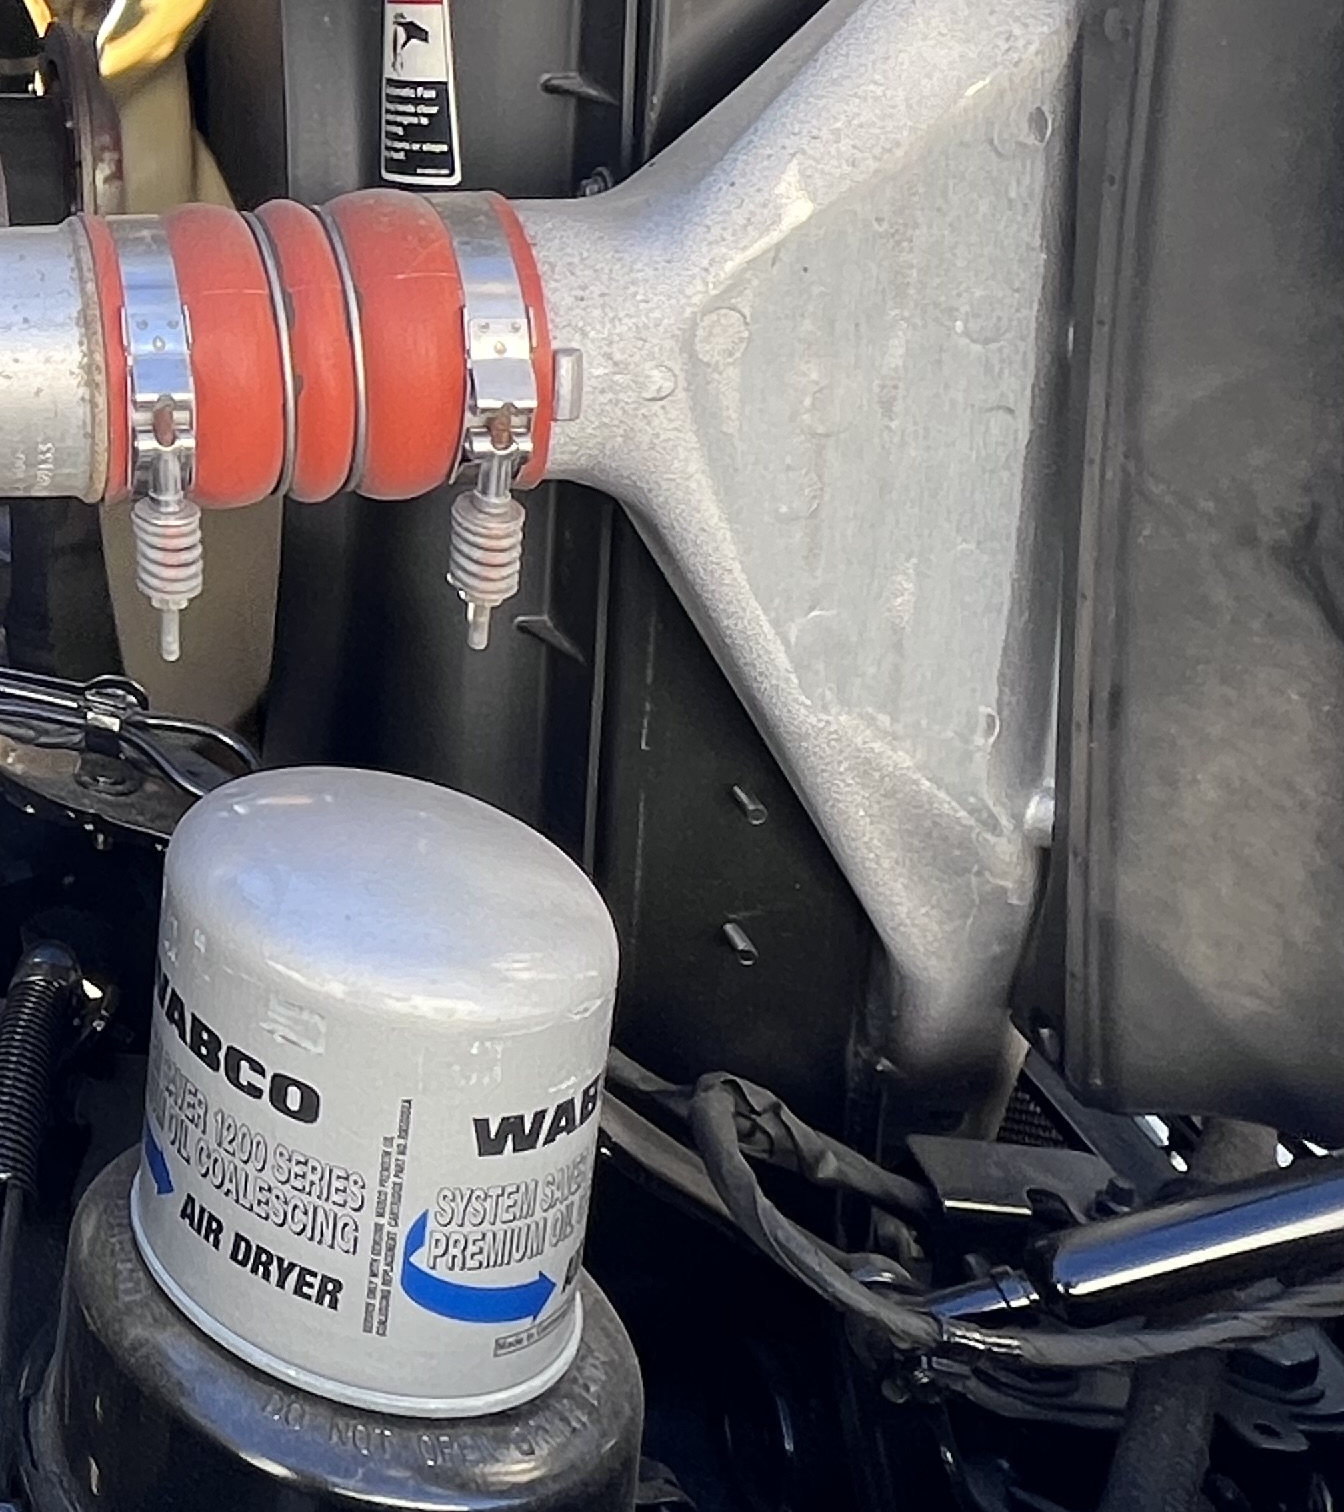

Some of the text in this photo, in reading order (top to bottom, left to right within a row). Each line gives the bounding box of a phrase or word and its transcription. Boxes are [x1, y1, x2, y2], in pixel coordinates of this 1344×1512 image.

[195, 1137, 360, 1256] COALESCING
[213, 1108, 268, 1173] 1200
[271, 1142, 367, 1213] SERIES
[433, 1178, 540, 1228] SYSTEM
[179, 1192, 344, 1311] AIR DRYER
[426, 1216, 548, 1272] PREMIUM
